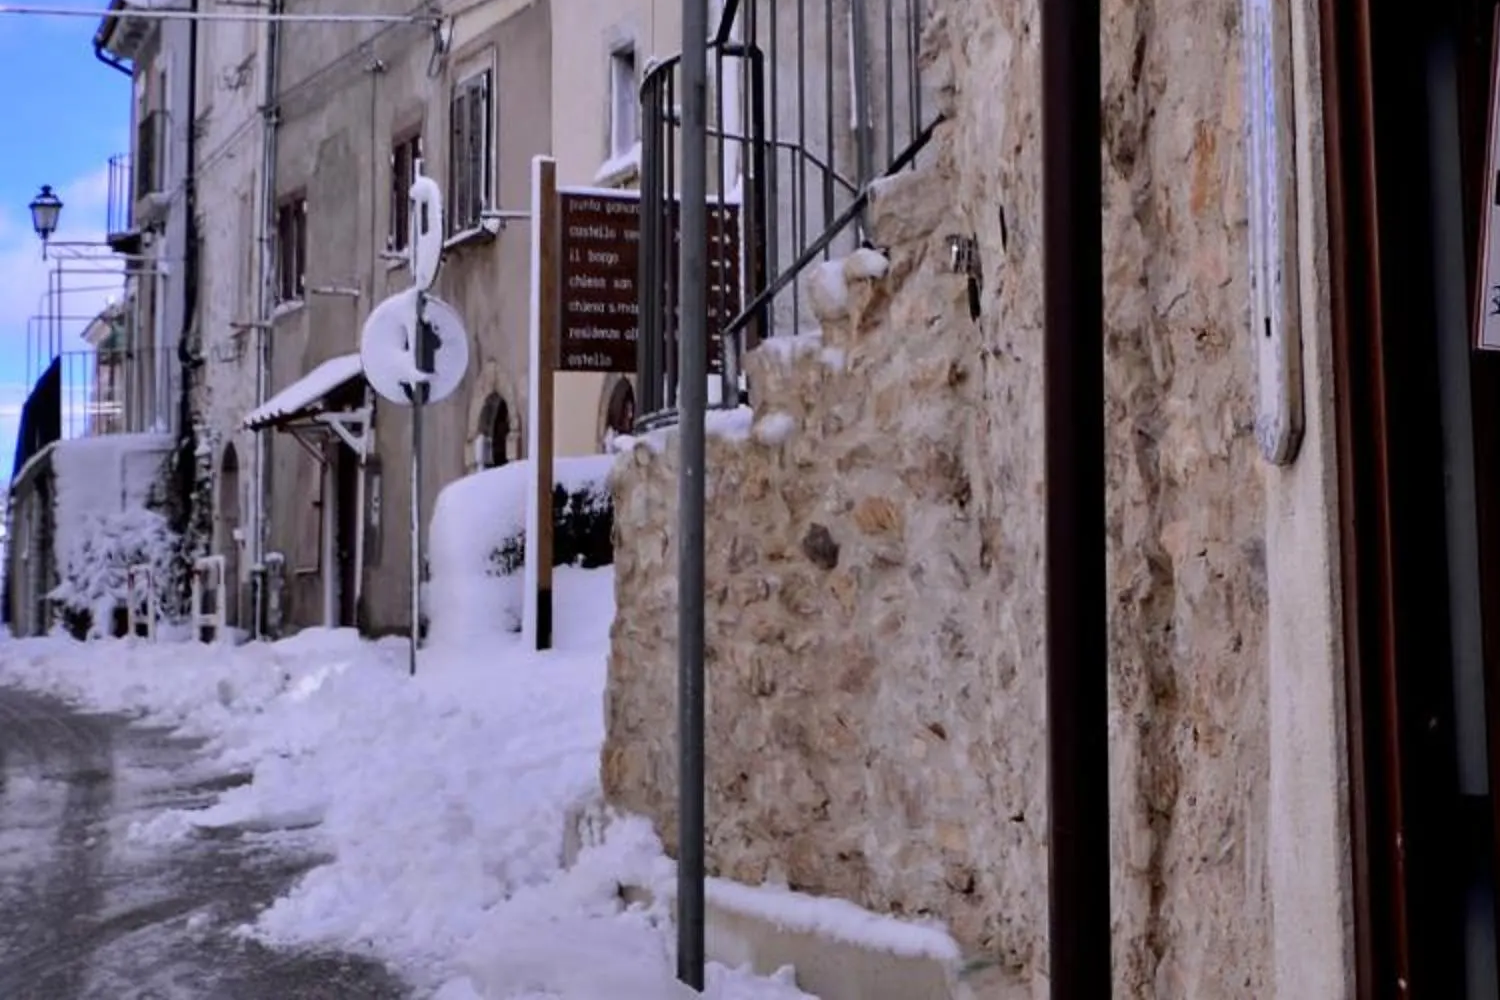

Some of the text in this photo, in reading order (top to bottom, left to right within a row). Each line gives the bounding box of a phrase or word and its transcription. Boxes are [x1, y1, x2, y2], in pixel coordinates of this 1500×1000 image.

[569, 248, 619, 267] il borgo
[569, 274, 633, 290] chiesa san
[567, 352, 612, 368] ostello
